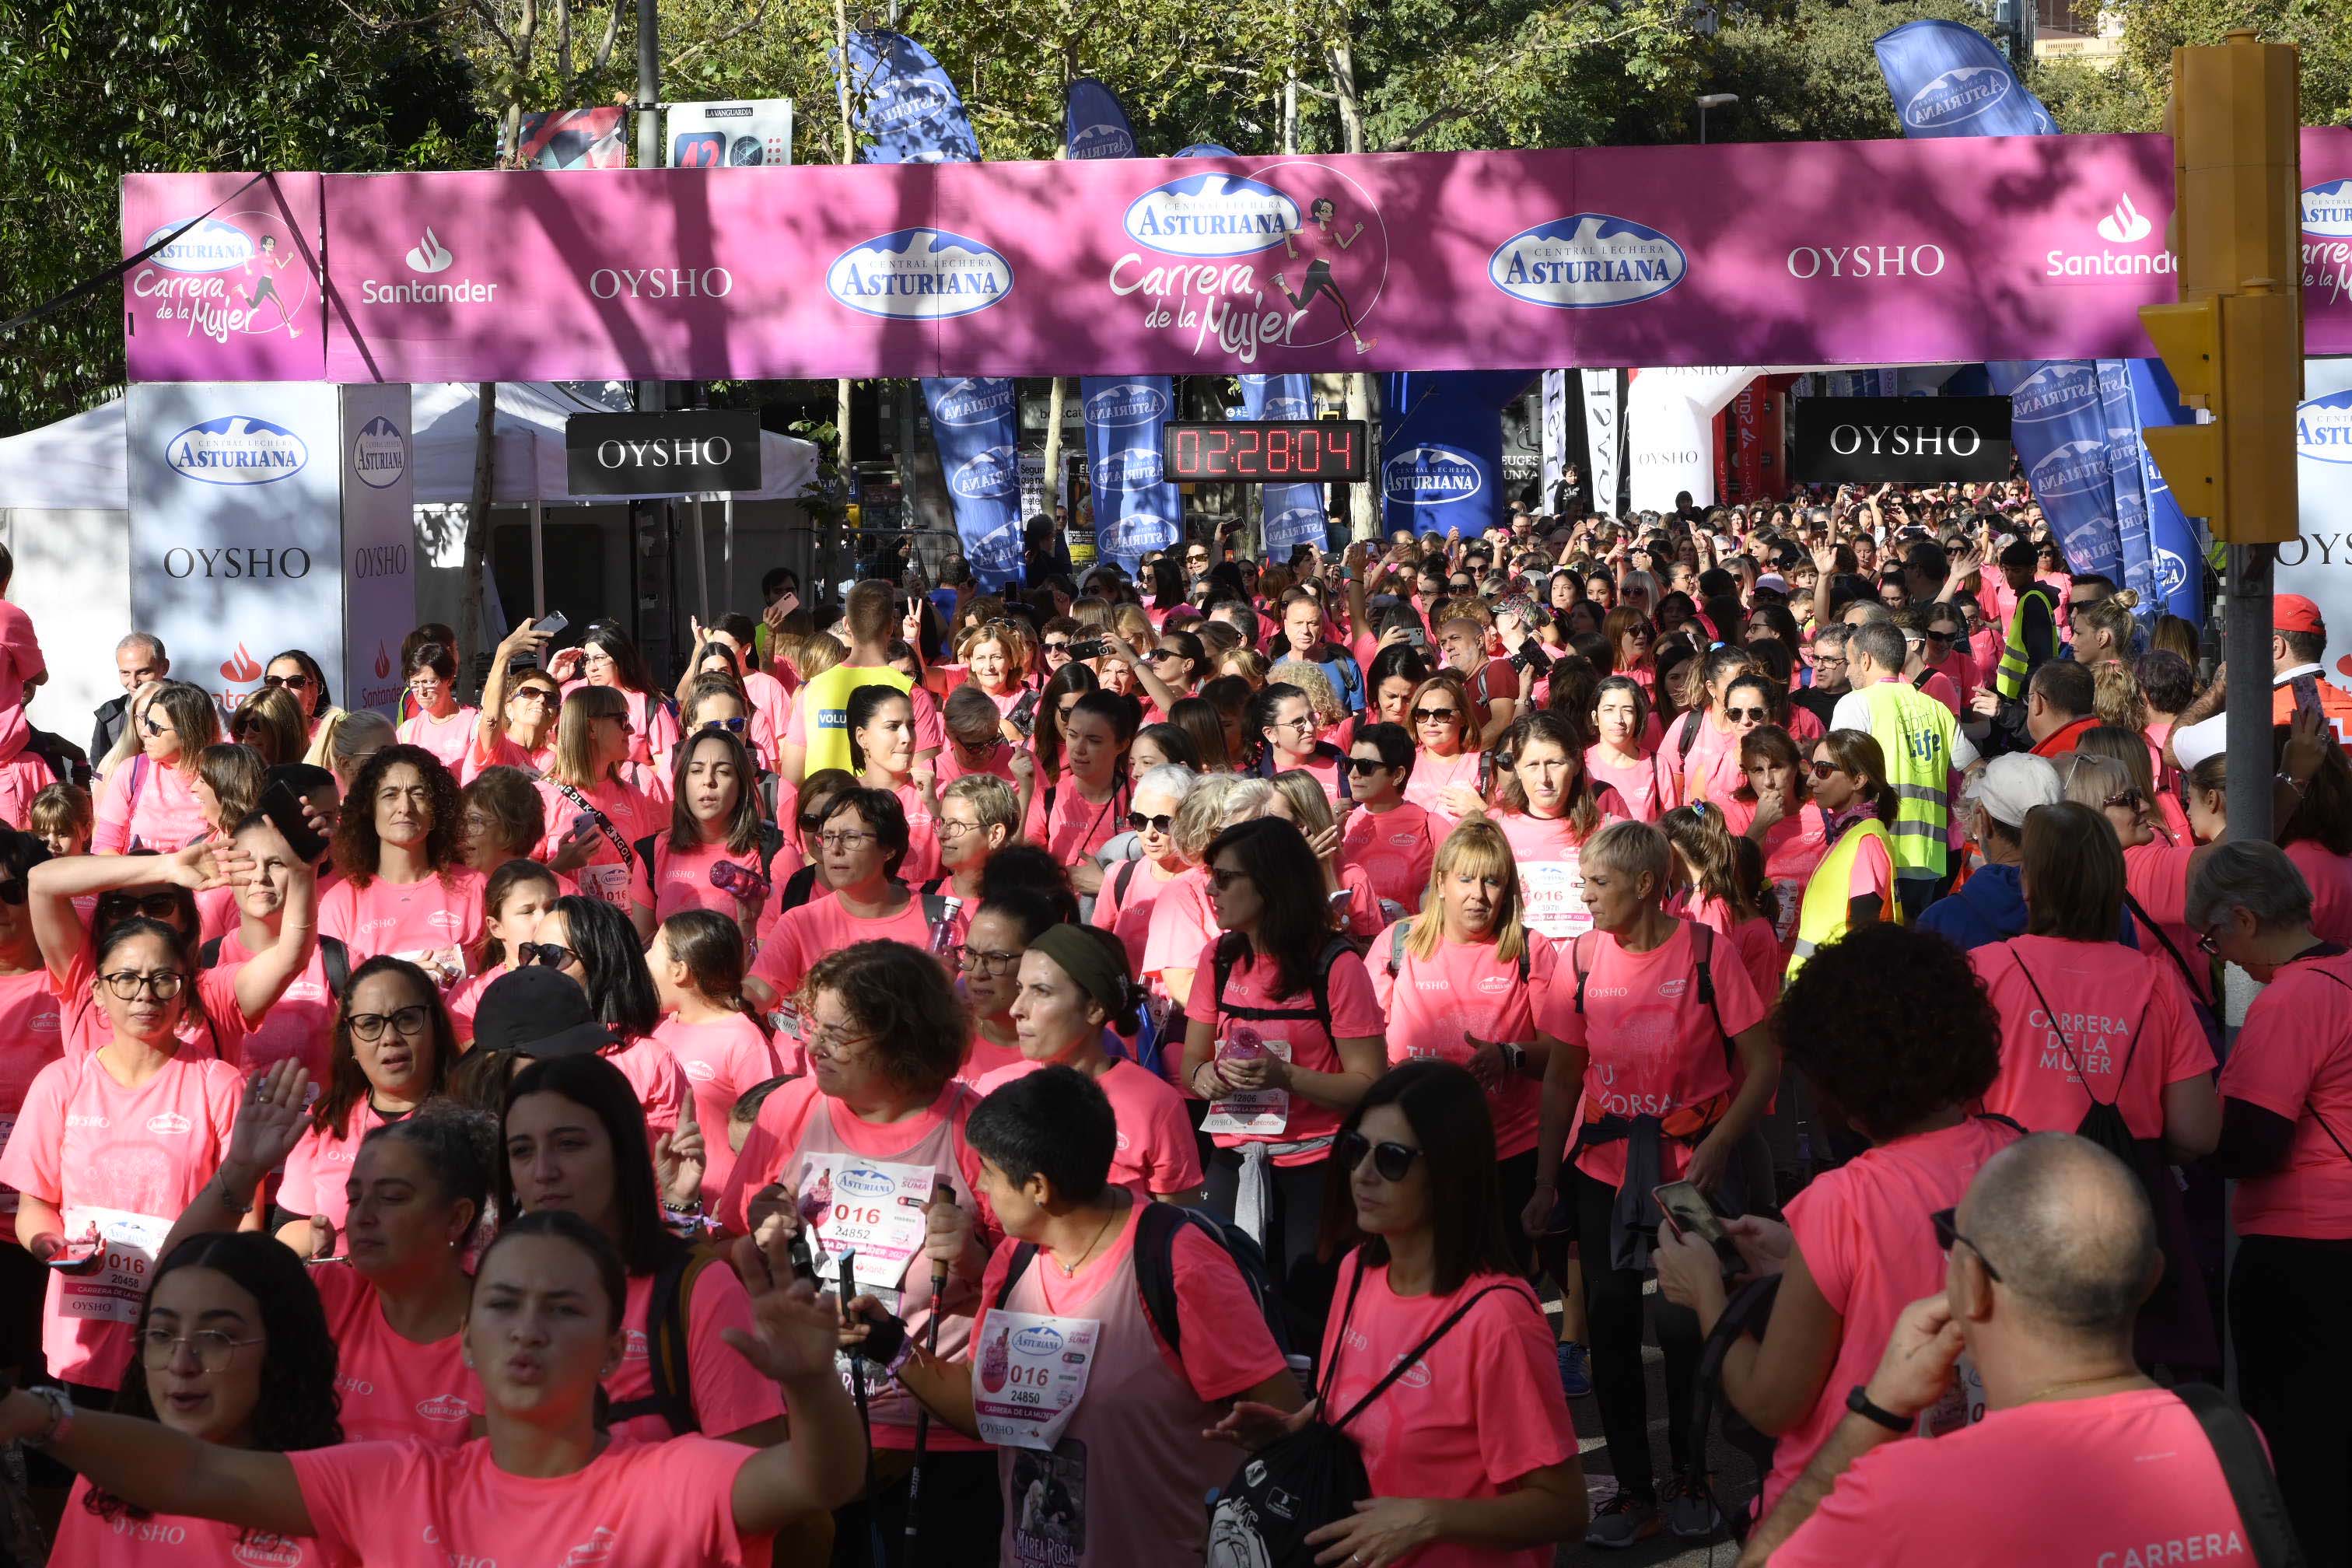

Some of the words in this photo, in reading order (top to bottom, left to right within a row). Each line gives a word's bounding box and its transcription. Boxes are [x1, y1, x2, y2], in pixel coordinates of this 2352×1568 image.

[1138, 205, 1286, 236] ASTURIANA
[152, 237, 244, 258] ASTURIANA
[1534, 247, 1596, 258] CENTRAL
[1601, 245, 1666, 256] LECHERA
[2301, 242, 2352, 265] arre
[869, 259, 928, 269] CENTRAL
[934, 259, 993, 269] LECHERA
[1503, 250, 1671, 285] ASTURIANA
[1787, 244, 1944, 278] OYSHO
[134, 269, 224, 298] Carrera
[590, 268, 733, 299] OYSHO
[842, 262, 999, 296] ASTURIANA
[1108, 253, 1255, 297] Carrera
[2319, 264, 2333, 287] la
[363, 278, 498, 304] Santander
[156, 300, 173, 320] de
[177, 299, 189, 320] la
[187, 296, 259, 344] Mujer
[1145, 299, 1171, 329] de
[1178, 298, 1197, 328] la
[1193, 291, 1308, 364] Mujer
[597, 436, 732, 468] OYSHO
[1177, 429, 1351, 474] 02:28:04
[1829, 424, 1981, 457] OYSHO
[177, 441, 299, 467] ASTURIANA
[356, 443, 403, 471] ASTURIANA
[1639, 450, 1699, 465] OYSHO
[1387, 471, 1475, 492] ASTURIANA
[163, 548, 310, 579] OYSHO
[355, 544, 406, 579] OYSHO
[1906, 729, 1940, 761] Life
[666, 870, 696, 879] OYSHO
[1534, 891, 1564, 902] 016
[1589, 986, 1629, 999] OYSHO
[772, 1014, 797, 1031] OYSHO
[2028, 1010, 2128, 1036] CARRERA
[2047, 1031, 2076, 1052] DE
[2083, 1035, 2109, 1054] LA
[2039, 1051, 2112, 1074] MUJER
[840, 1176, 891, 1194] ASTURIANA
[901, 1181, 927, 1191] SUMA
[835, 1204, 881, 1225] 016
[835, 1226, 871, 1241] 24852
[109, 1253, 145, 1275] 016
[77, 1286, 113, 1297] CARRERA
[111, 1273, 139, 1290] 20458
[72, 1300, 112, 1314] OYSHO
[1017, 1334, 1058, 1352] ASTURIANA
[1010, 1364, 1050, 1387] 016
[1010, 1390, 1041, 1405] 24850
[984, 1405, 1012, 1414] CARRERA
[980, 1423, 1015, 1437] OYSHO
[112, 1517, 186, 1545] OYSHO
[239, 1545, 299, 1564] ASTURIANA
[1016, 1529, 1045, 1563] MAREA
[1047, 1538, 1076, 1568] ROSA
[2098, 1528, 2243, 1568] CARRERA
